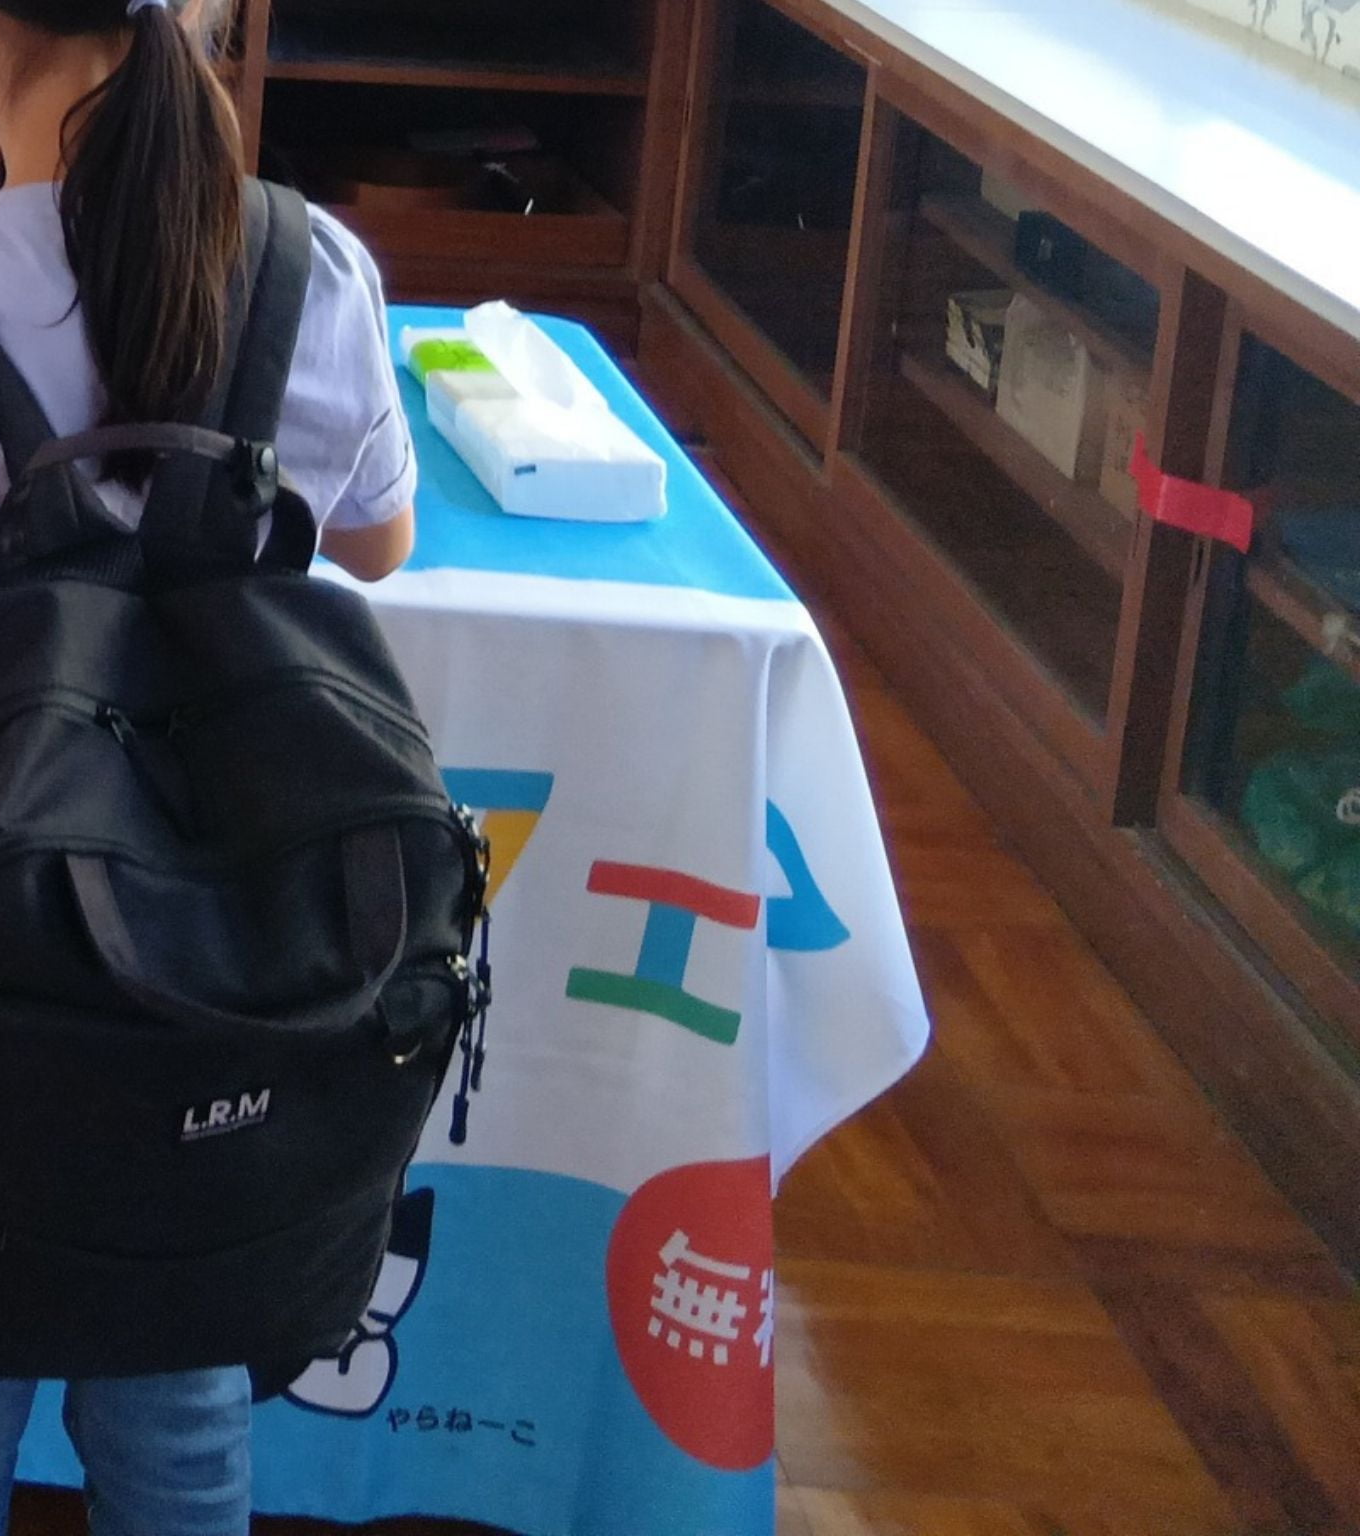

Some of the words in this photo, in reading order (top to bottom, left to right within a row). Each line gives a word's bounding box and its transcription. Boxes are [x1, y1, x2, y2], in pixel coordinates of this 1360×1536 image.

[182, 1088, 271, 1134] L.R.M
[385, 1406, 538, 1447] やらねーこ
